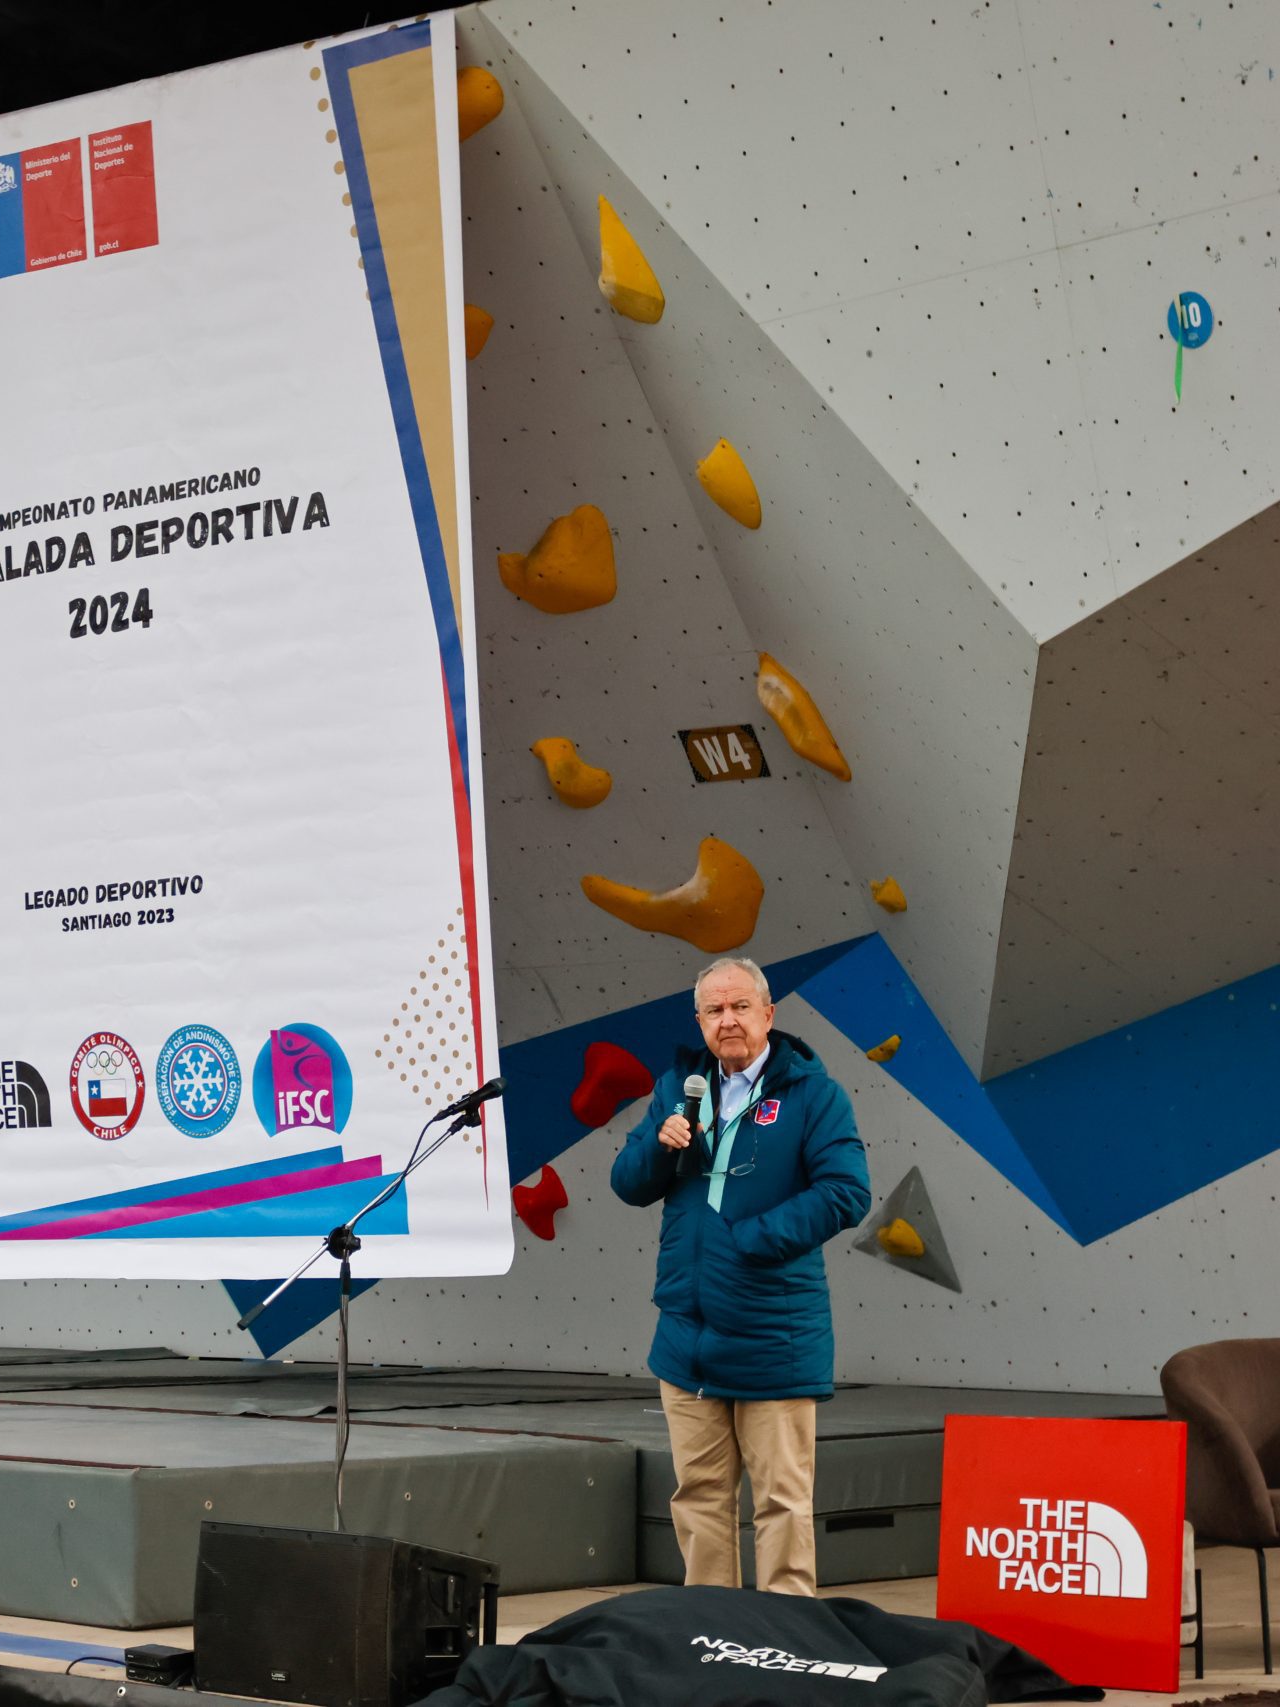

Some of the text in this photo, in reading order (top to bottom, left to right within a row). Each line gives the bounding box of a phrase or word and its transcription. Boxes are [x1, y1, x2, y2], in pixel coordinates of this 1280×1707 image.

[25, 152, 71, 169] Ministerio del
[94, 143, 134, 159] Nacional de
[26, 169, 52, 182] Deporte
[95, 157, 125, 171] Deportes
[30, 249, 83, 267] Gobierno de Chile
[99, 240, 119, 253] gob.cl
[102, 466, 261, 512] PANAMERICANO
[110, 491, 330, 562] DEPORTIVA
[68, 587, 154, 639] 2024
[692, 732, 752, 776] W4
[24, 875, 204, 911] LEGADO DEPORTIVO
[61, 908, 175, 932] SANTIAGO 2023
[173, 1036, 185, 1049] DE
[185, 1031, 230, 1060] ANDINISMO
[226, 1062, 236, 1078] DE
[222, 1081, 237, 1114] CHILE
[93, 1124, 127, 1139] CHILE
[1019, 1498, 1086, 1531] THE
[966, 1526, 1085, 1563] NORTH
[998, 1559, 1083, 1595] FACE
[714, 1651, 811, 1672] FACE
